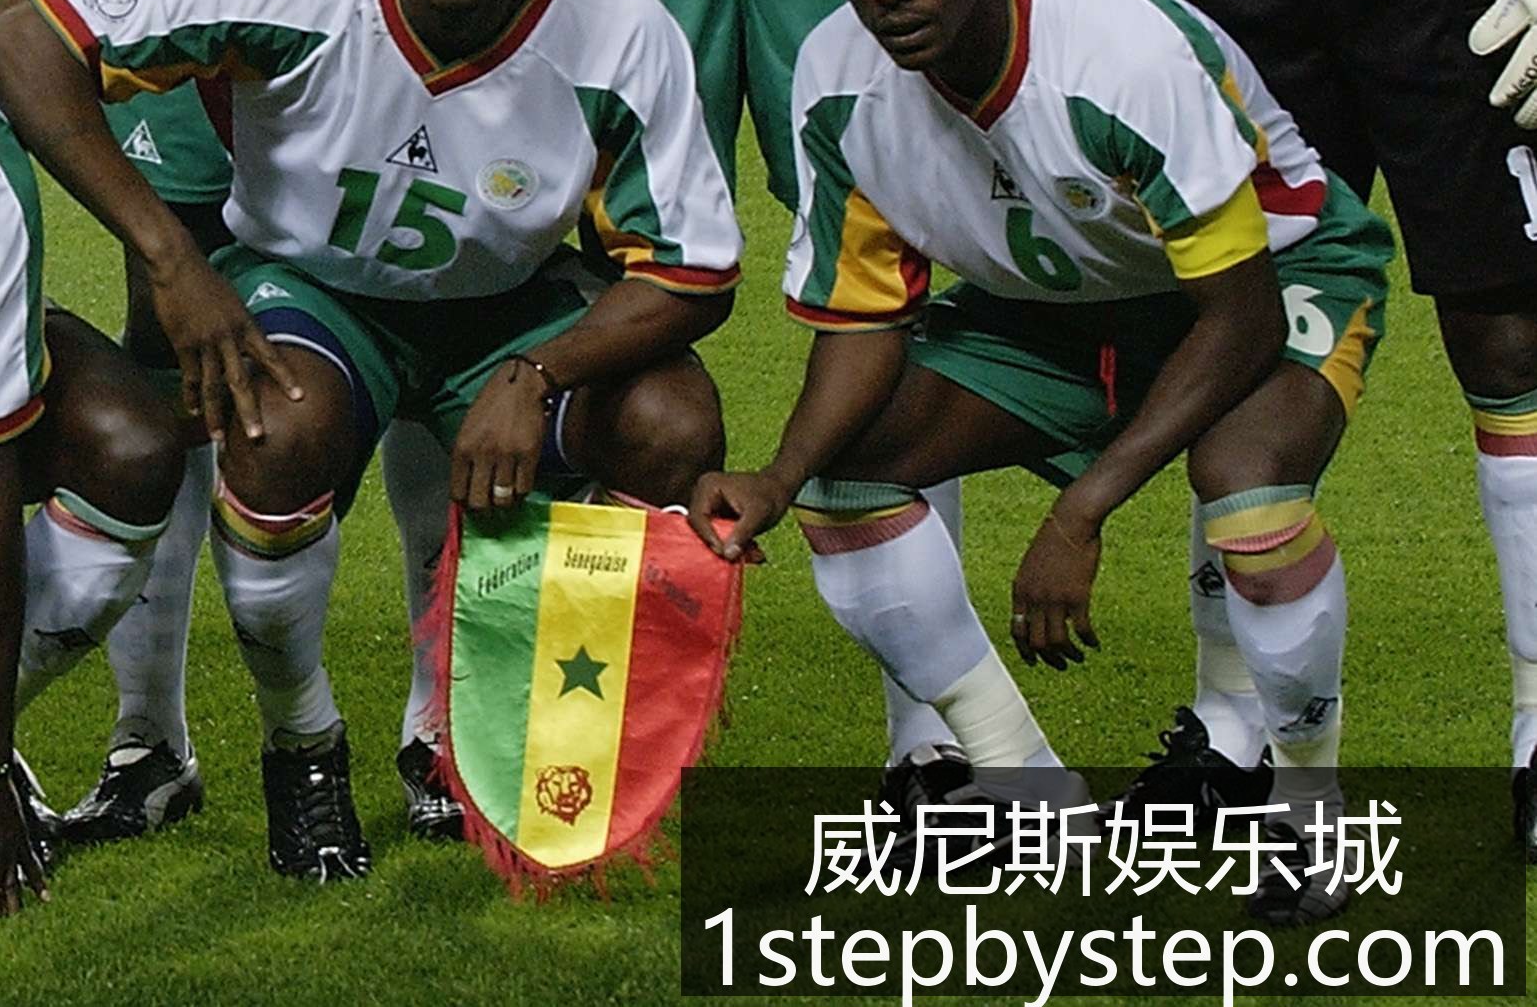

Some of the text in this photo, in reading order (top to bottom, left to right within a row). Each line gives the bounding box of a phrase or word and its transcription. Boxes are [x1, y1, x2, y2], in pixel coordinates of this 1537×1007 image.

[327, 167, 468, 271] 15
[1005, 206, 1083, 292] 6
[1281, 283, 1335, 358] 6
